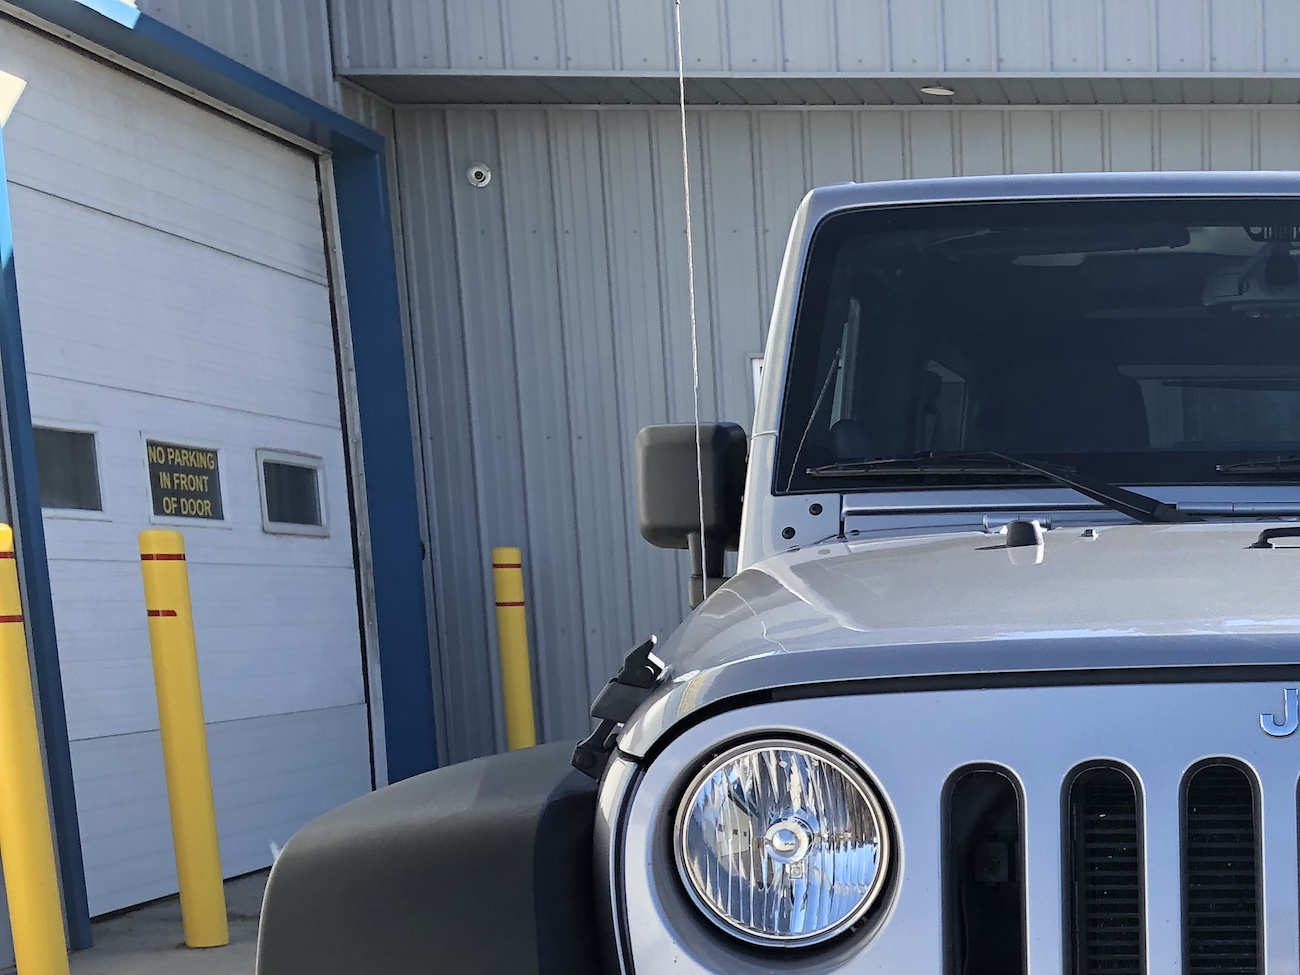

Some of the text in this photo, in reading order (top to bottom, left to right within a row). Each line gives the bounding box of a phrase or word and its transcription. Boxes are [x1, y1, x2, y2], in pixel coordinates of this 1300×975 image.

[148, 445, 215, 469] NO PARKING
[159, 472, 209, 492] IN FRONT
[162, 496, 212, 516] OF DOOR
